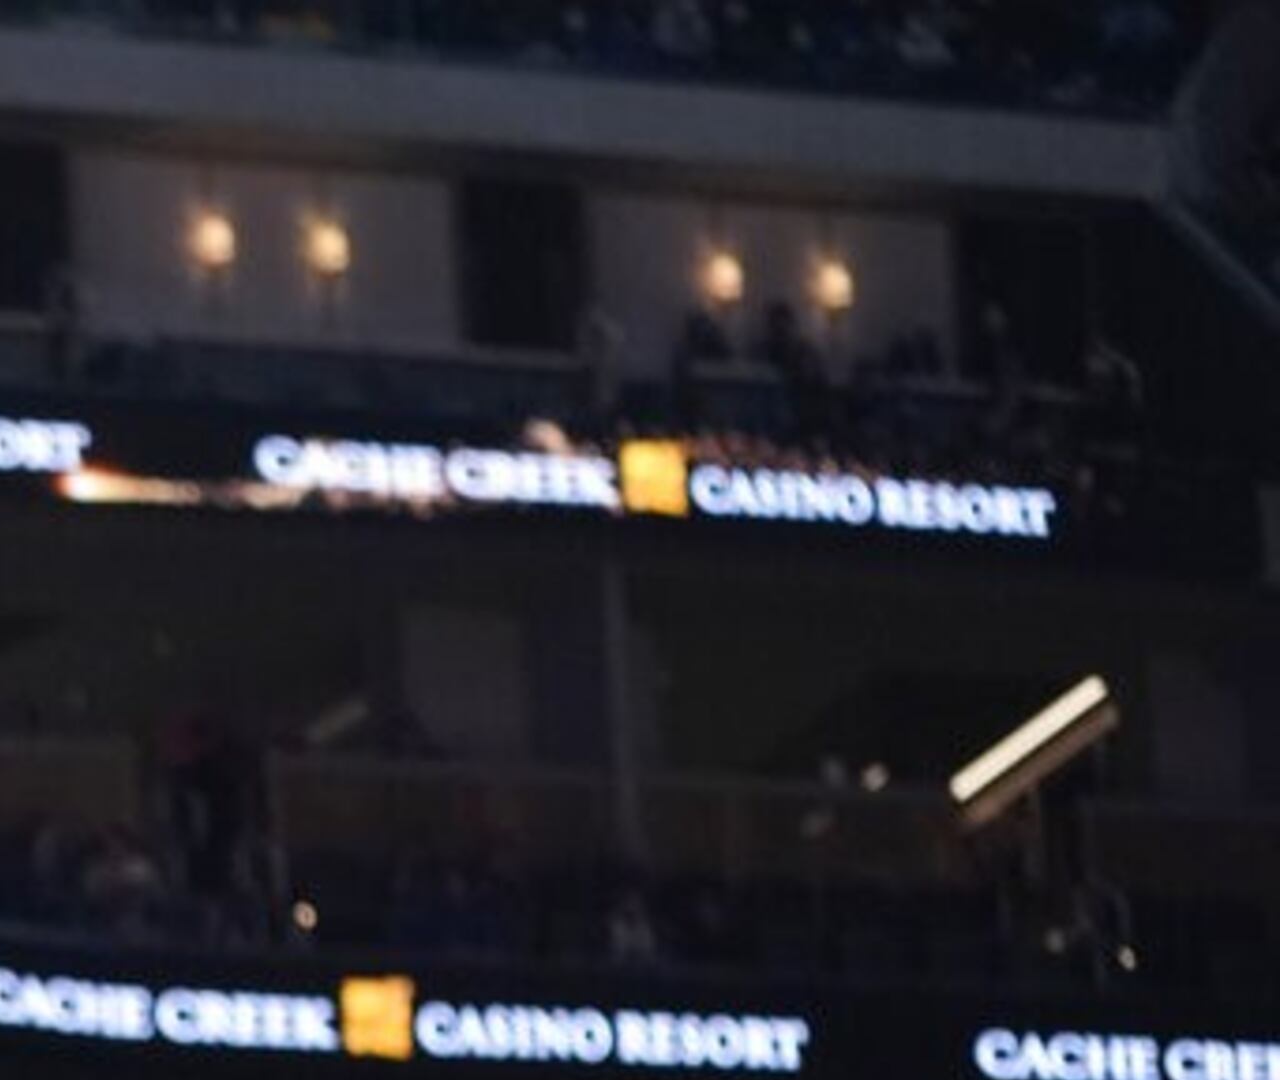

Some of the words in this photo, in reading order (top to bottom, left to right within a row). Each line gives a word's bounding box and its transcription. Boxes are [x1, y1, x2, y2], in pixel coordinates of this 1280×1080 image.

[254, 434, 443, 495] CACHE
[445, 447, 622, 511] CREEK
[690, 464, 874, 525] CASINO
[876, 475, 1055, 537] RESORT
[154, 987, 339, 1051] CREEK
[415, 1001, 613, 1063] CASINO
[615, 1010, 809, 1071] RESORT
